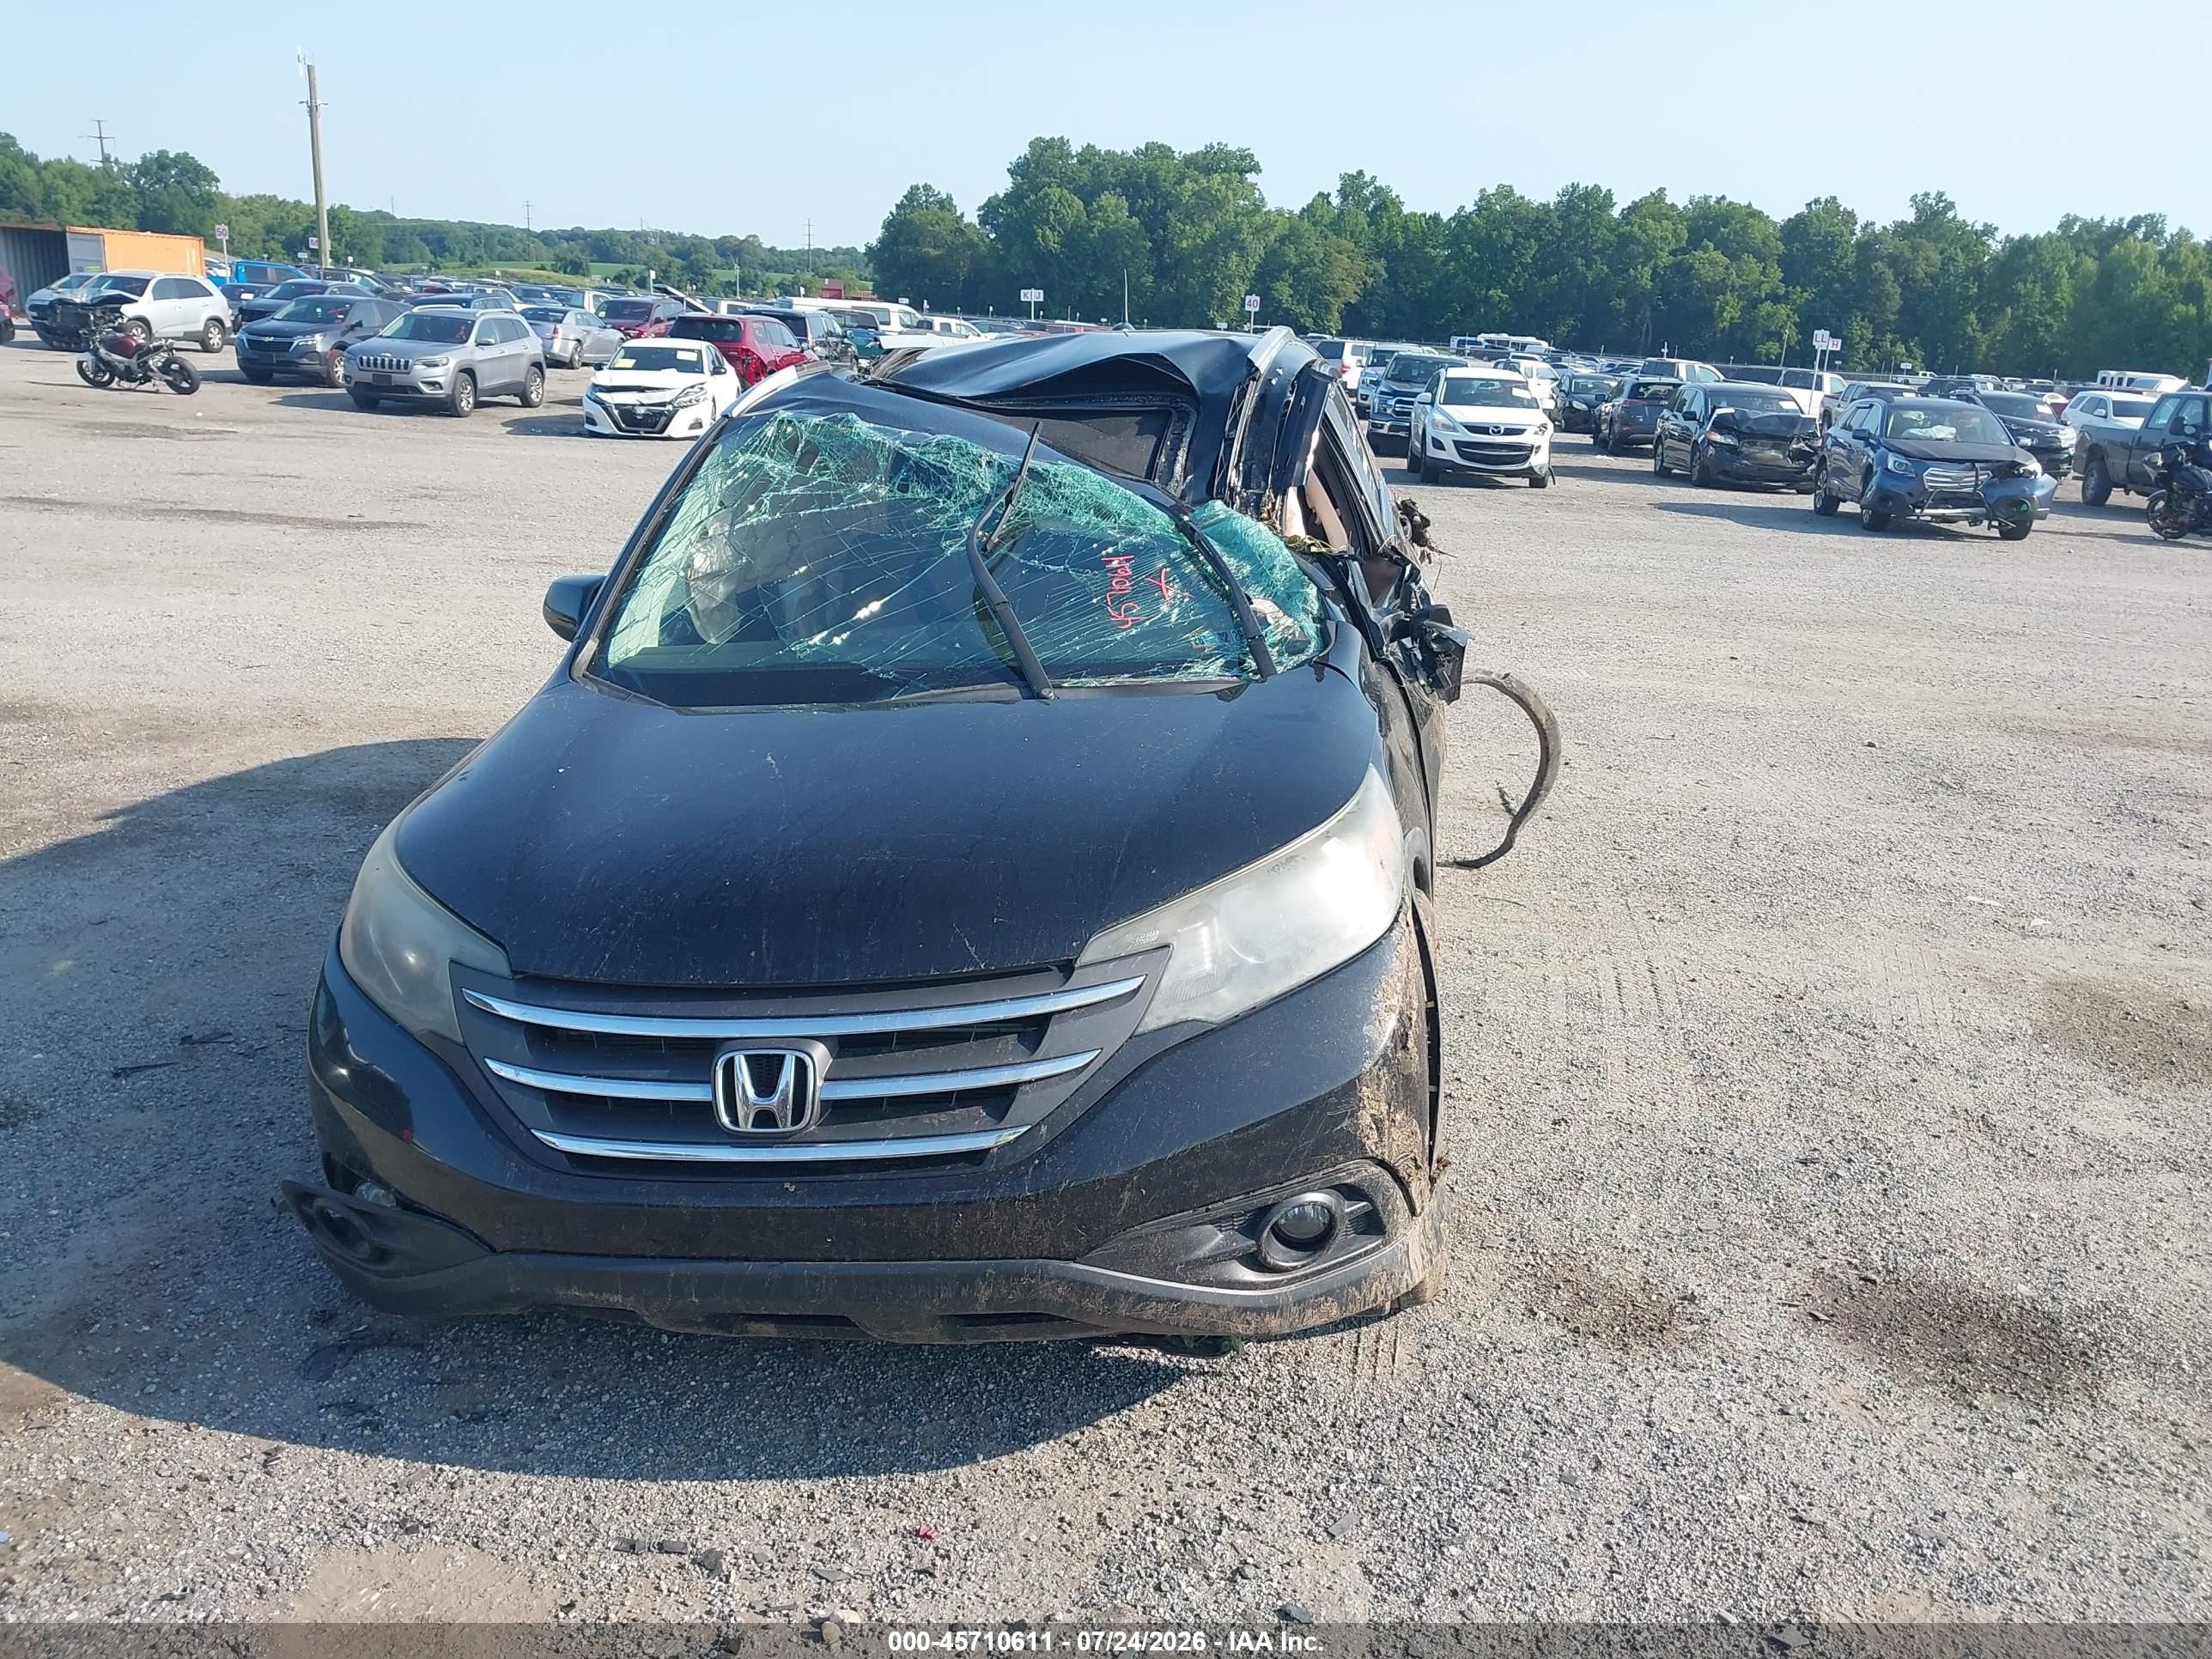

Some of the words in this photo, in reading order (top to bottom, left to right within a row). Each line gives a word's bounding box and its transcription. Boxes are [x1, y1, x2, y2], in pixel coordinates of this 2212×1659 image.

[216, 228, 228, 237] 50
[1023, 291, 1030, 300] K
[1246, 299, 1259, 308] 40
[1814, 333, 1827, 343] LL
[1831, 340, 1839, 349] H
